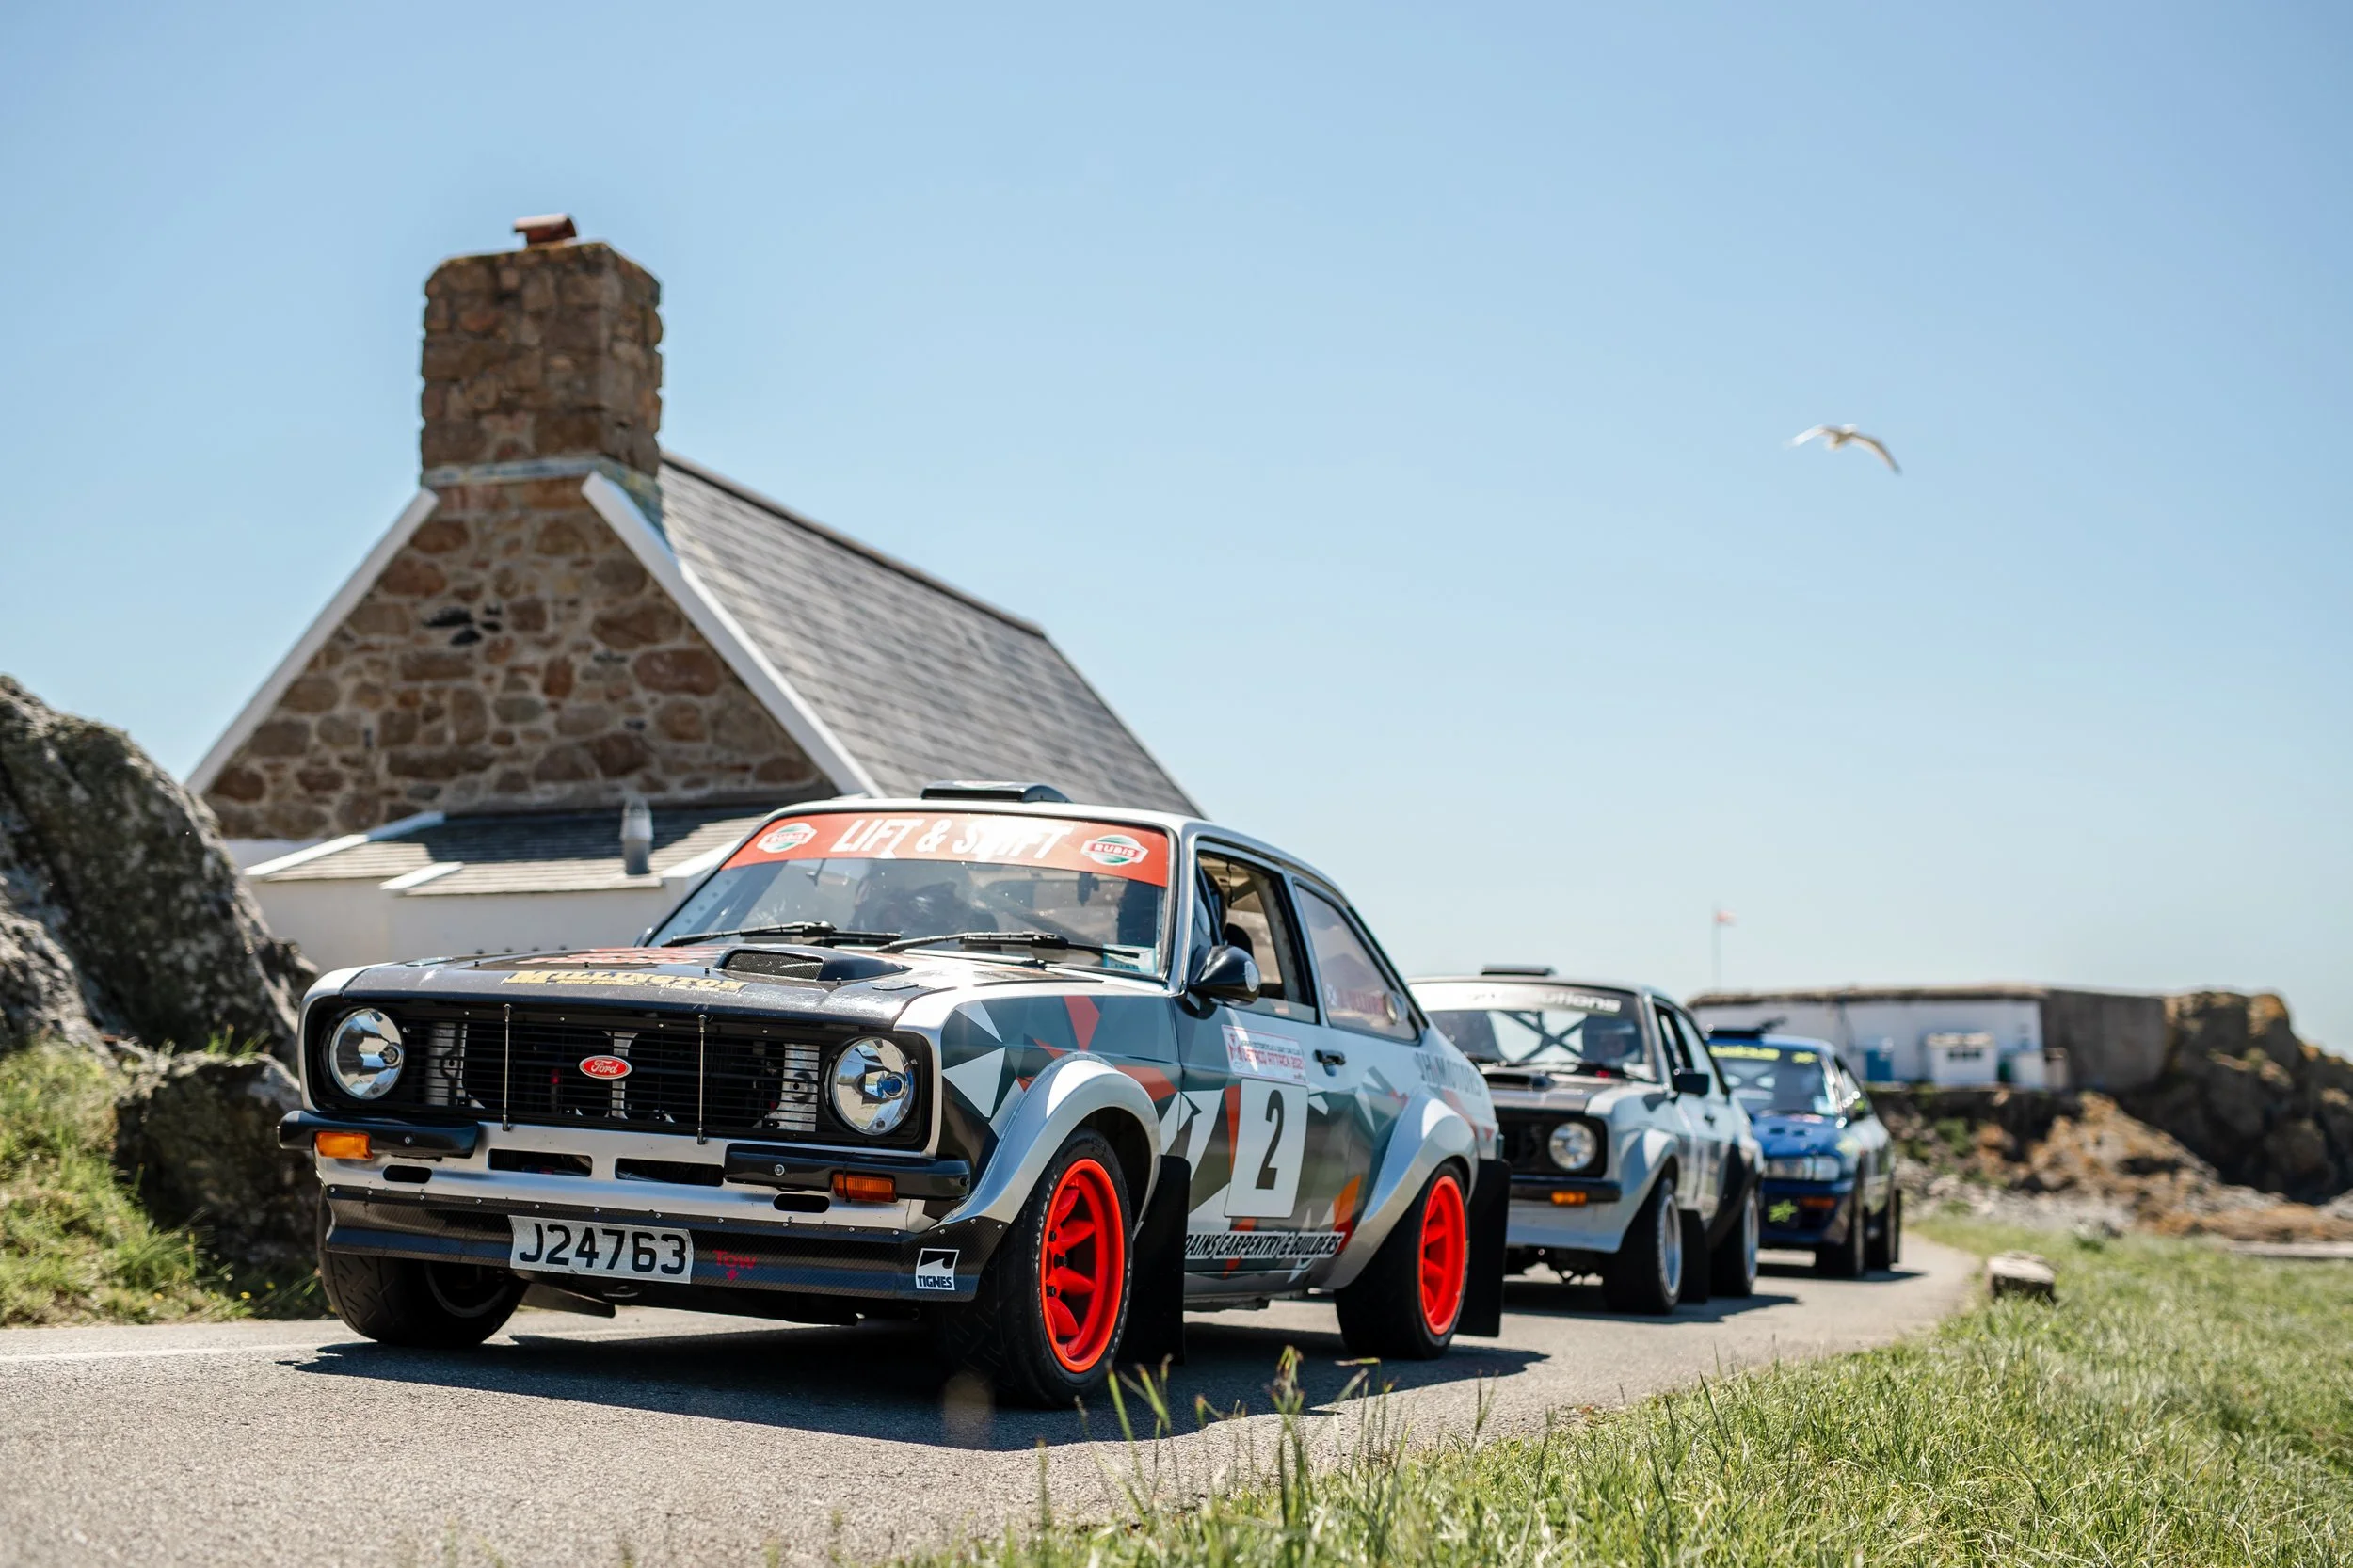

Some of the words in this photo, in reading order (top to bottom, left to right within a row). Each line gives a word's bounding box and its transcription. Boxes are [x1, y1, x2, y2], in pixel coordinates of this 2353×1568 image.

[829, 818, 926, 854] LIFT
[914, 819, 952, 853] &
[952, 819, 1075, 859] SIFT
[504, 970, 750, 991] MILLINGTON
[590, 1059, 619, 1074] Ford
[1255, 1089, 1285, 1190] 2
[519, 1223, 686, 1275] J24763
[1216, 1234, 1284, 1256] CARPENTRY
[1289, 1235, 1343, 1255] BUILDERS
[918, 1275, 952, 1288] TIGNES
